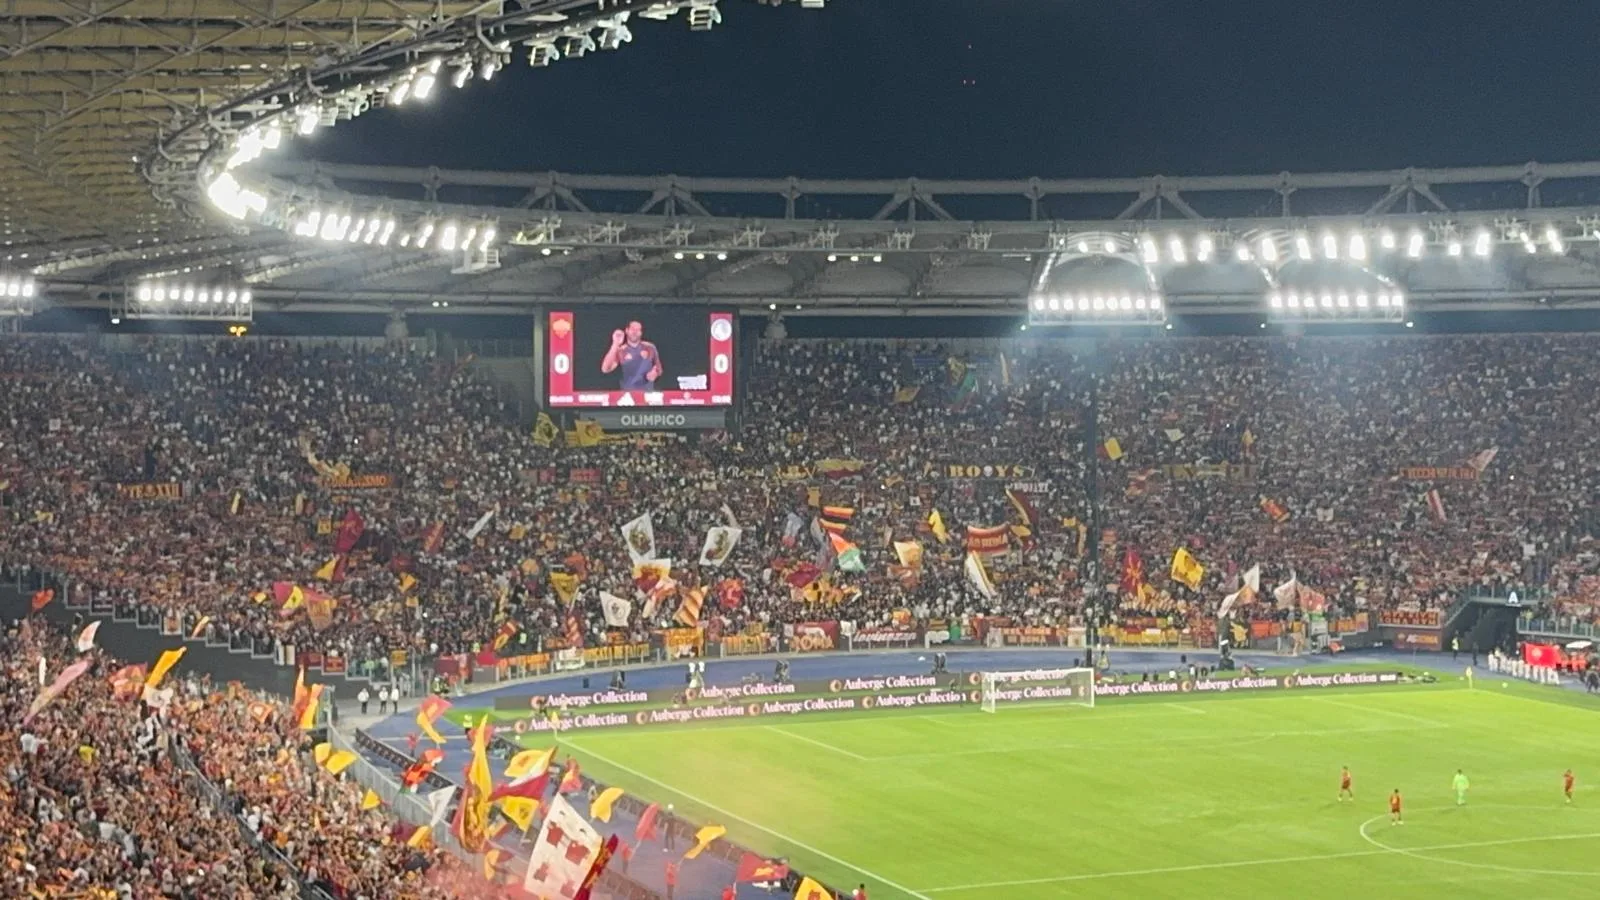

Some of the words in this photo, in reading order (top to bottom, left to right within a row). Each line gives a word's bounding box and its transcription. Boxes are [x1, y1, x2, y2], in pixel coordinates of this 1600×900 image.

[554, 353, 569, 374] 0
[714, 354, 728, 374] 0
[621, 414, 685, 426] OLIMPICO
[1508, 591, 1519, 604] A
[843, 677, 885, 691] Auberge
[886, 675, 936, 688] Collection
[1131, 680, 1178, 693] Collection
[1195, 679, 1231, 692] Auberge
[1231, 677, 1277, 688] Collection
[1295, 674, 1332, 687] Auberge
[1333, 672, 1377, 684] Collection
[743, 682, 795, 695] Collection
[1024, 686, 1072, 698] Collection
[546, 693, 592, 707] Auberge
[592, 690, 648, 704] Collection
[763, 701, 802, 714] Auberge
[804, 698, 854, 710] Collection
[876, 694, 916, 707] Auberge
[574, 713, 628, 727] Collection
[650, 709, 692, 723] Auberge
[693, 705, 744, 718] Collection
